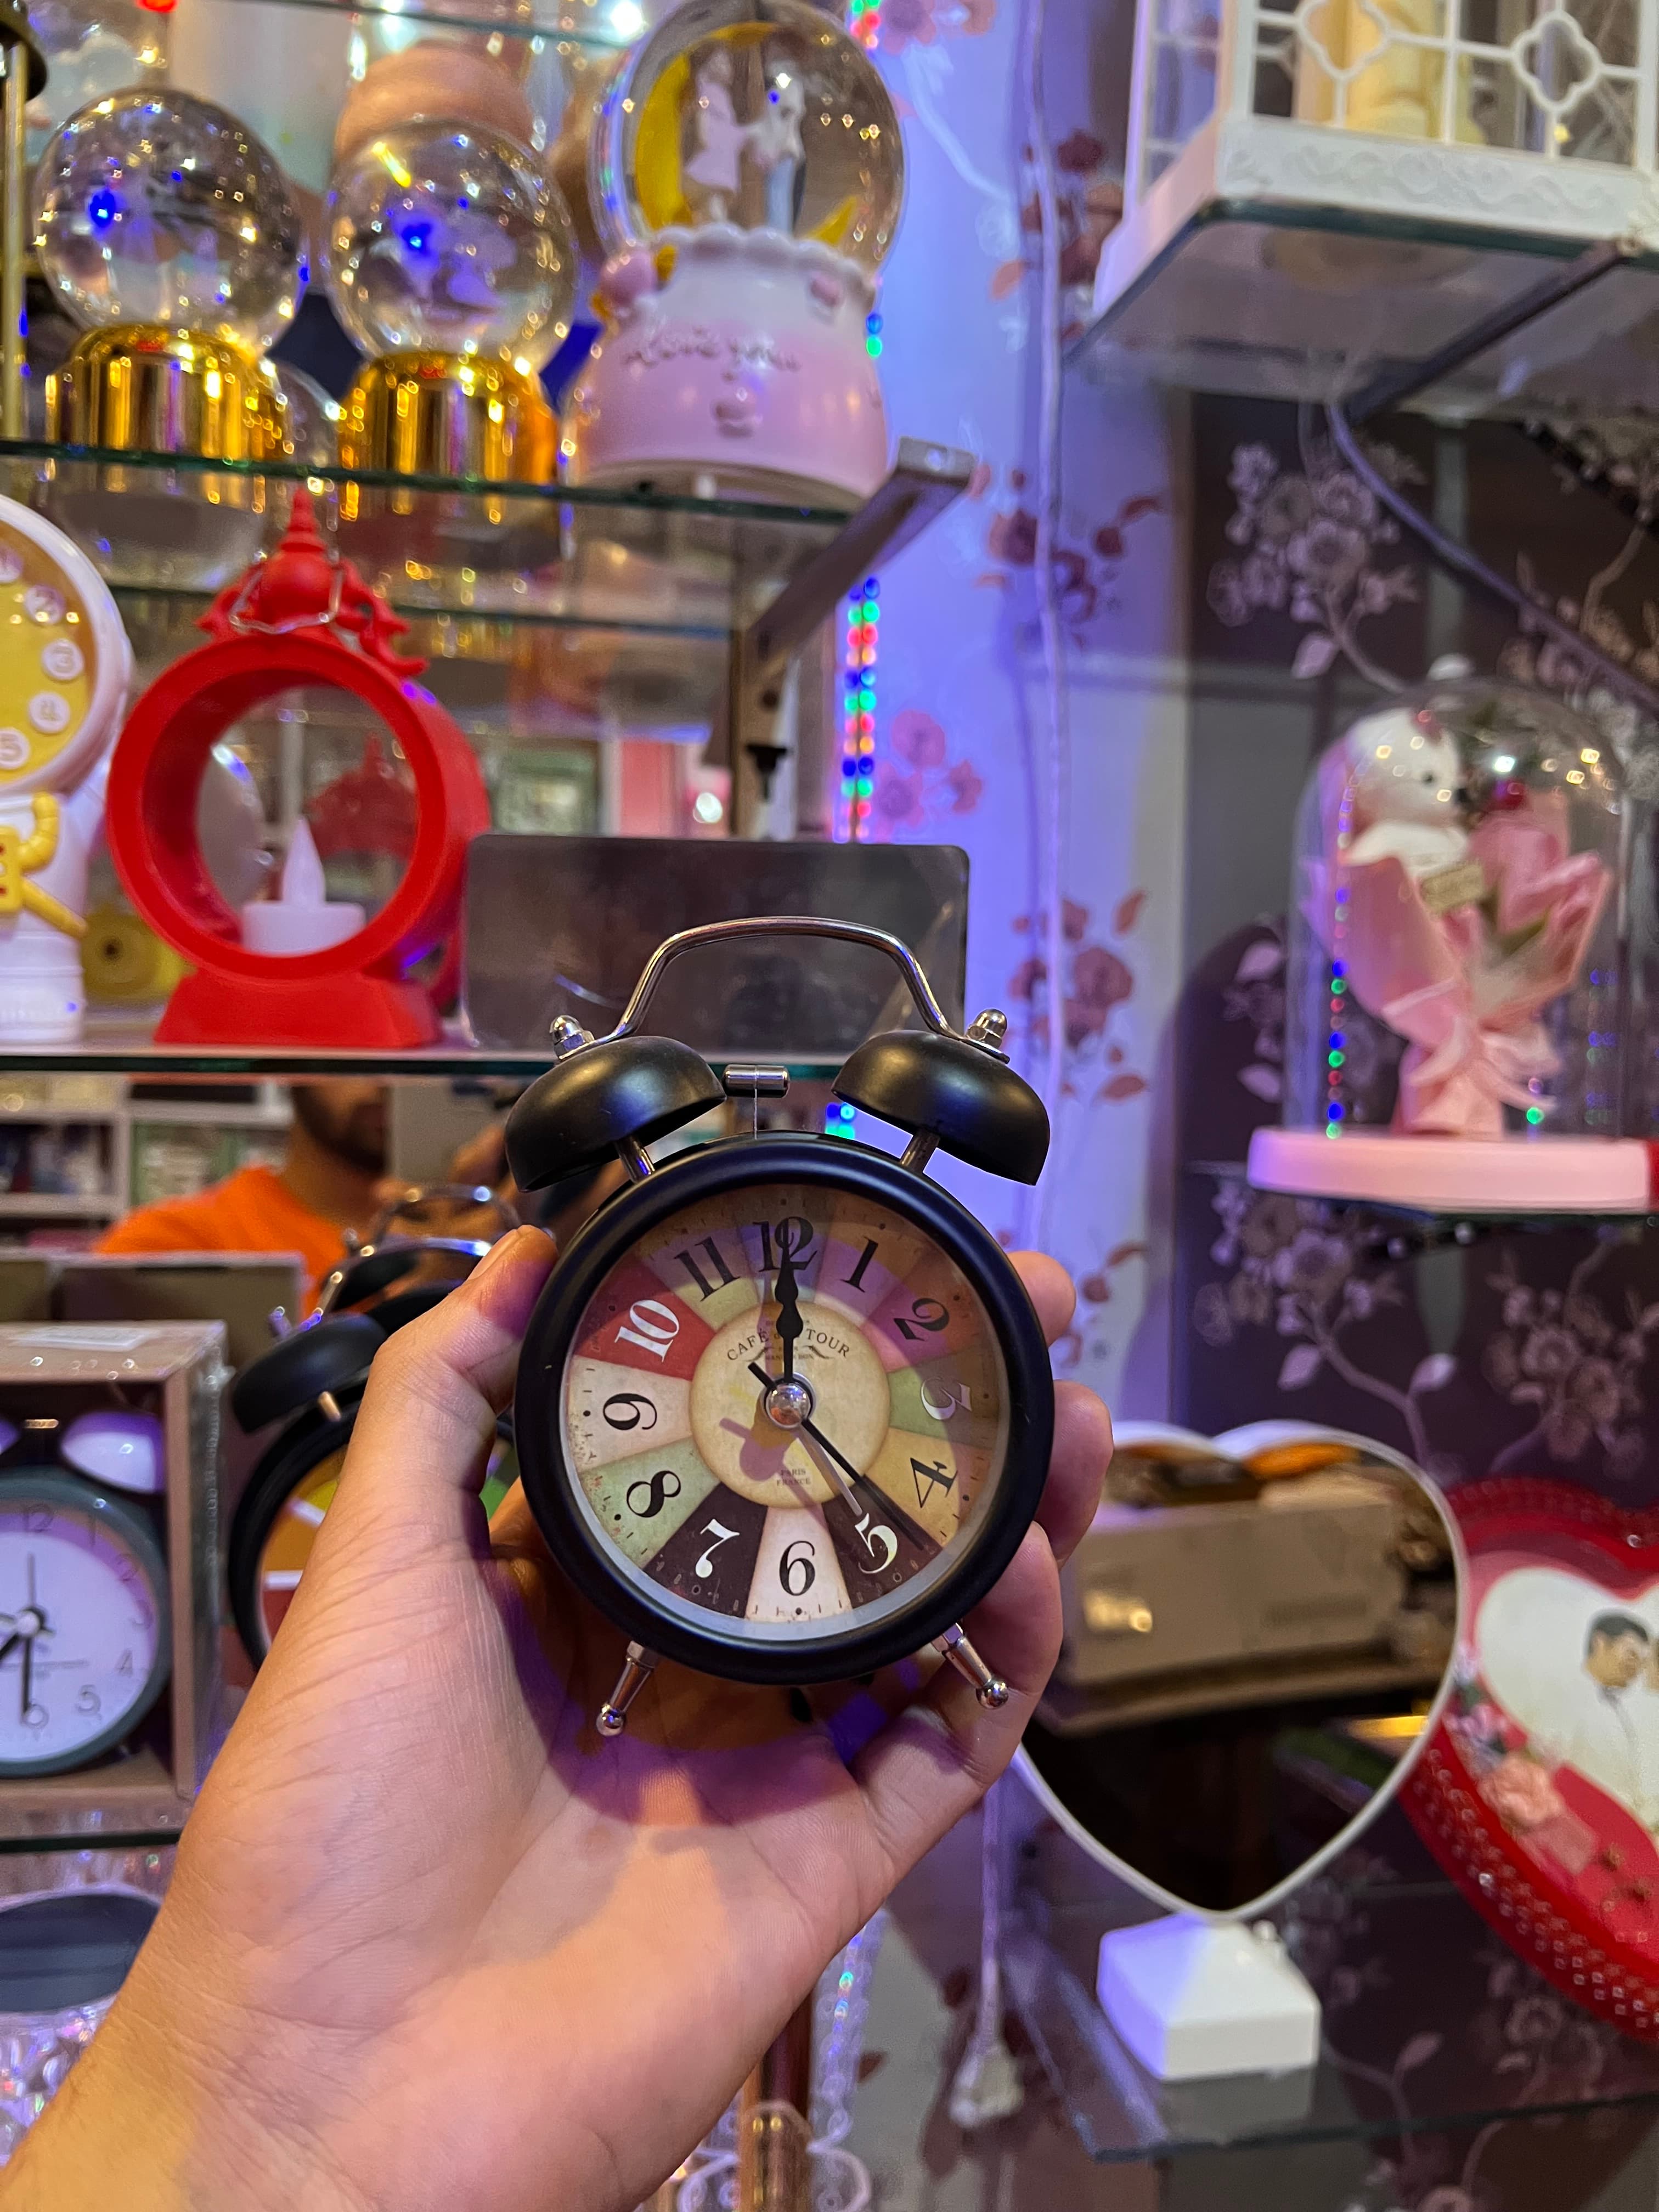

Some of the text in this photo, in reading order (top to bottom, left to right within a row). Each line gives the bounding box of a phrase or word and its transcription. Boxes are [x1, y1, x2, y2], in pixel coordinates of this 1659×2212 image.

[753, 1216, 817, 1272] 12
[840, 1237, 878, 1293] 1
[673, 1237, 741, 1302] 11
[614, 1299, 680, 1363] 10
[894, 1297, 950, 1341] 2
[727, 1328, 850, 1361] CAFÉ TOUR
[603, 1392, 657, 1431] 9
[921, 1376, 973, 1420] 3
[626, 1470, 681, 1518] 8
[776, 1478, 811, 1486] FRANCE
[910, 1457, 959, 1508] 4
[695, 1518, 740, 1578] 7
[779, 1540, 816, 1596] 6
[854, 1513, 898, 1574] 5
[113, 1647, 134, 1677] 4
[75, 1683, 103, 1716] 5
